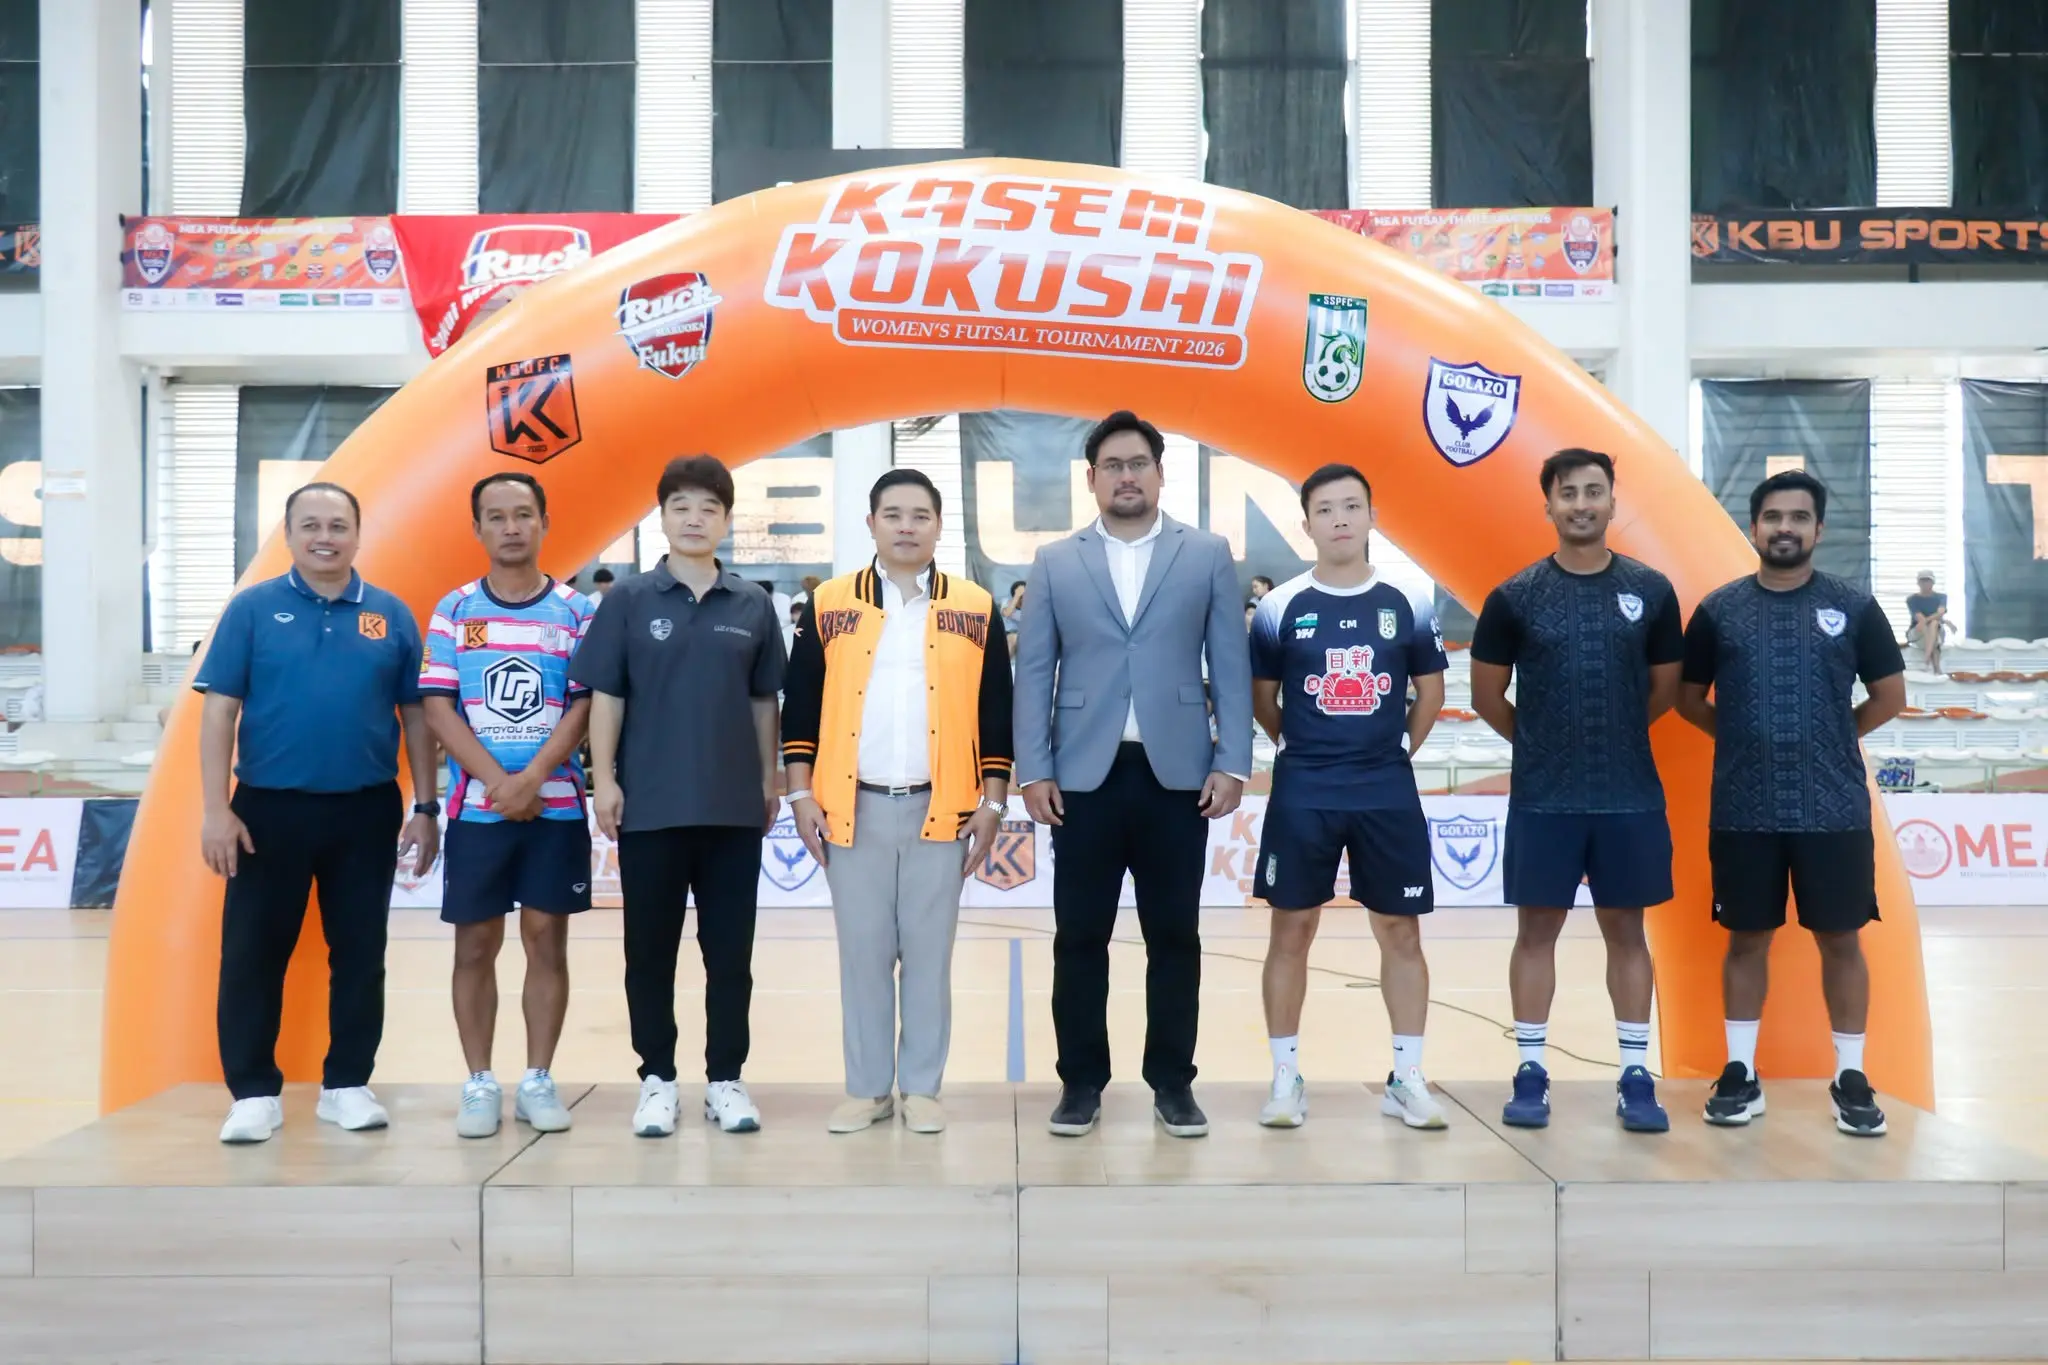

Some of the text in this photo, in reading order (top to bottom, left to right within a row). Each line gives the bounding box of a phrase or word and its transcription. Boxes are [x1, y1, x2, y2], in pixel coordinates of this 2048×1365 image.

[829, 178, 1205, 244] KASEM
[1727, 219, 2048, 251] KBU SPORT
[776, 233, 1251, 327] KOKUSAI
[622, 280, 713, 329] Ruck
[1323, 296, 1353, 306] SSPFC
[852, 317, 1226, 357] WOMEN'S FUTSAL TOURNAMENT 2026
[637, 339, 706, 369] Fukui
[1443, 373, 1505, 396] GOLAZO
[1446, 446, 1477, 456] FOOTBALL
[937, 610, 988, 649] BUNDIT
[1339, 619, 1357, 629] CM
[1330, 650, 1370, 669] 日新
[1440, 825, 1486, 836] GOLAZO
[1954, 823, 2048, 868] ME
